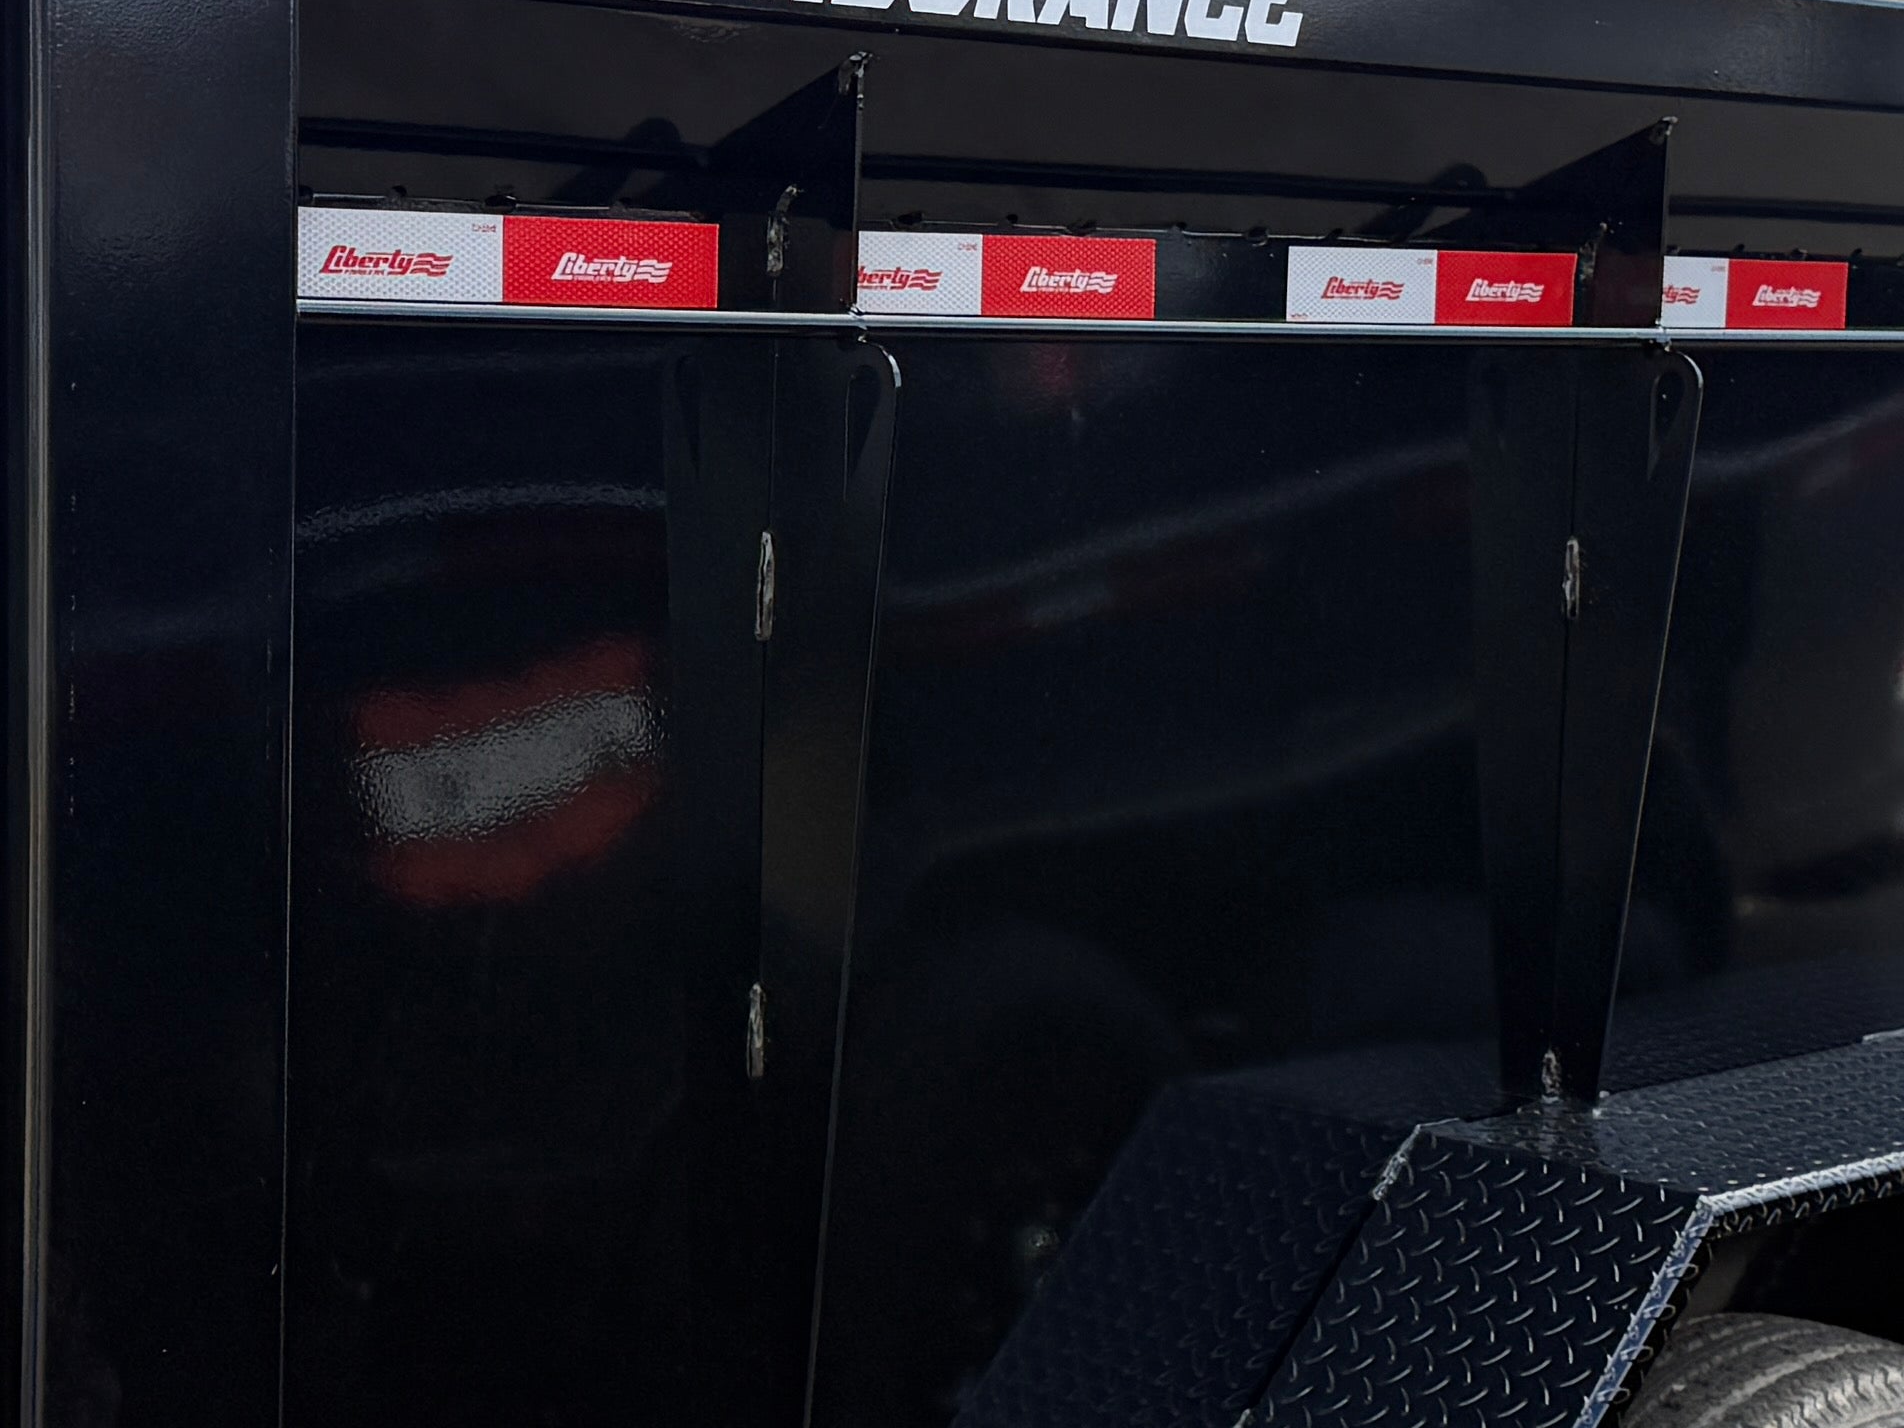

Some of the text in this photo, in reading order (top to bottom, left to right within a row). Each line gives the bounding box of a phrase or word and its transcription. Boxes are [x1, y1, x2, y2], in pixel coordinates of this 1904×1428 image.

[318, 244, 416, 276] Liberty
[550, 251, 639, 283] Liberty
[1019, 265, 1089, 293] Liberty
[1321, 276, 1381, 300] Liberty
[1465, 278, 1523, 303] Liberty
